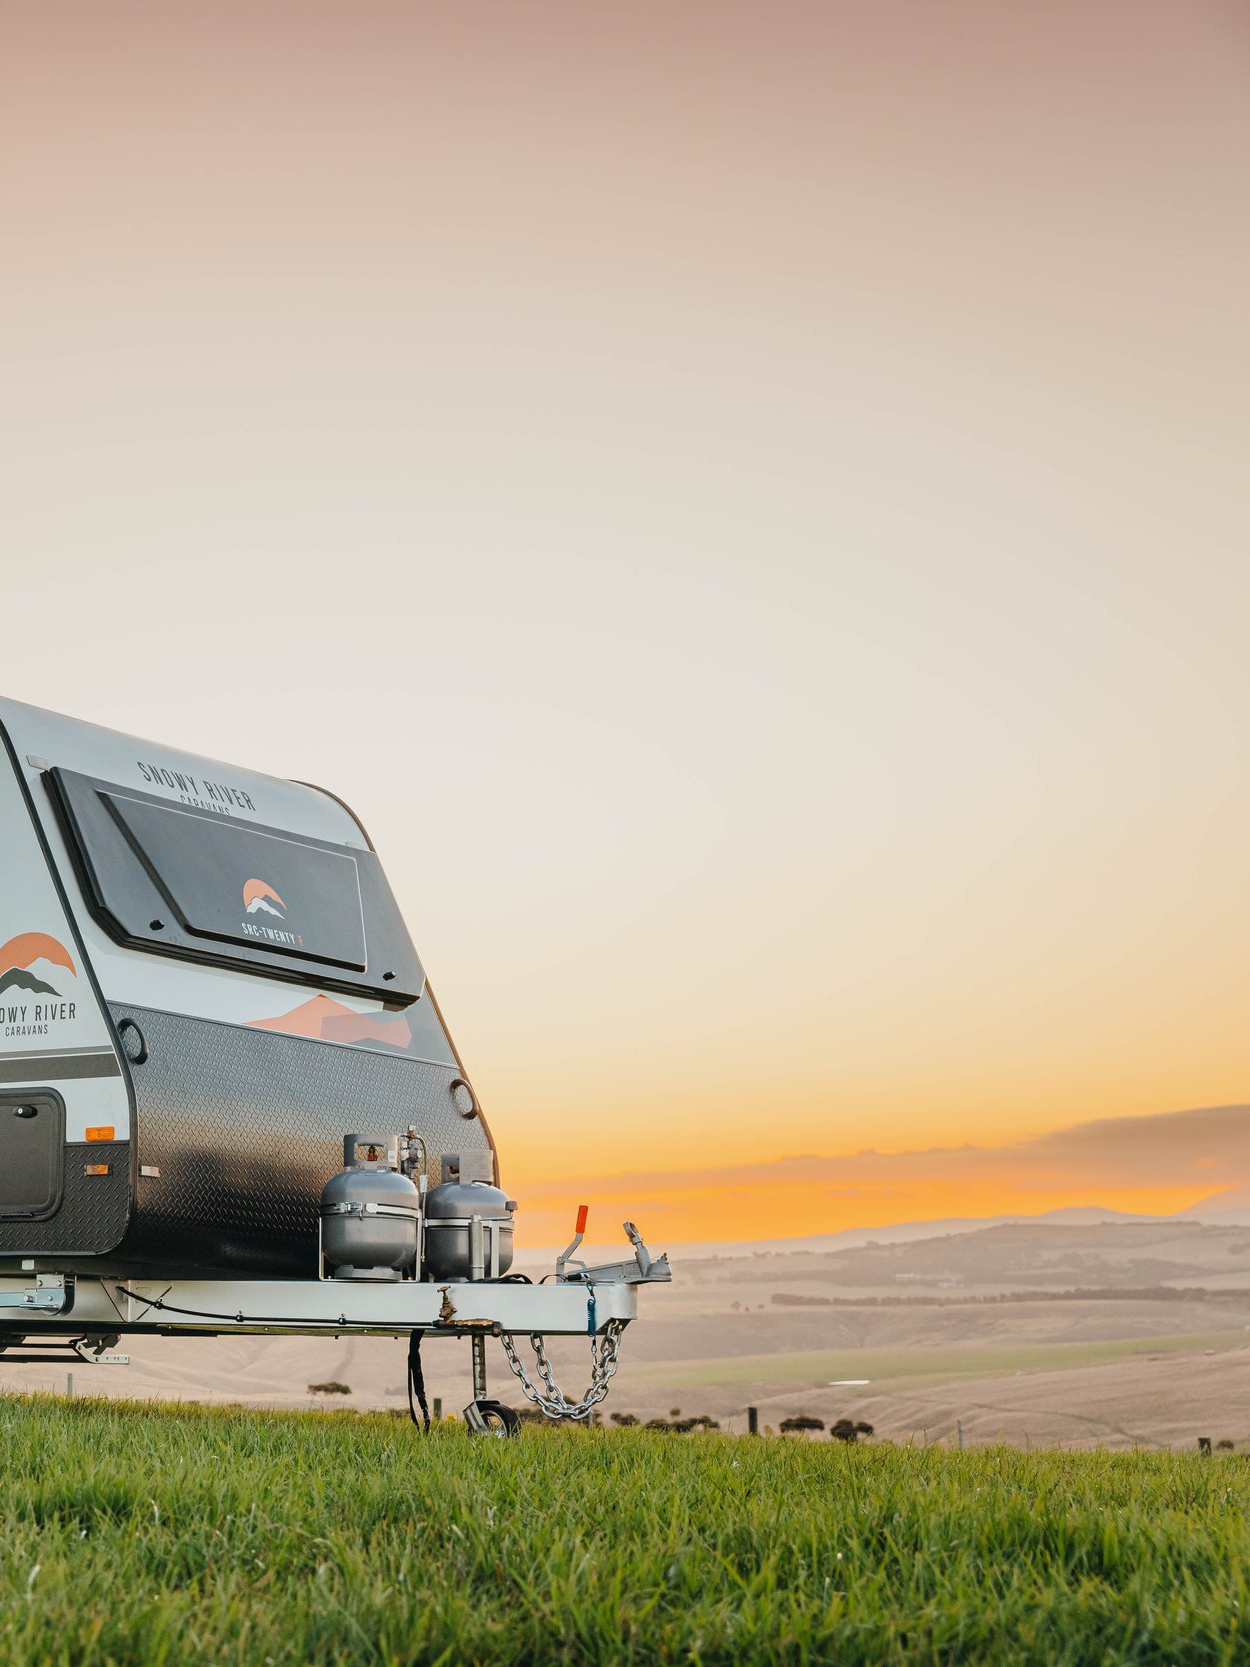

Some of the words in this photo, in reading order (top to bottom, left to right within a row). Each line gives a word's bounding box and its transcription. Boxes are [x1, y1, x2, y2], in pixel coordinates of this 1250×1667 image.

[137, 761, 199, 795] SNOWY
[202, 780, 256, 812] RIVER
[241, 922, 296, 945] SRC-TWENTY
[35, 1002, 76, 1022] RIVER
[5, 1024, 49, 1037] CARAVANS
